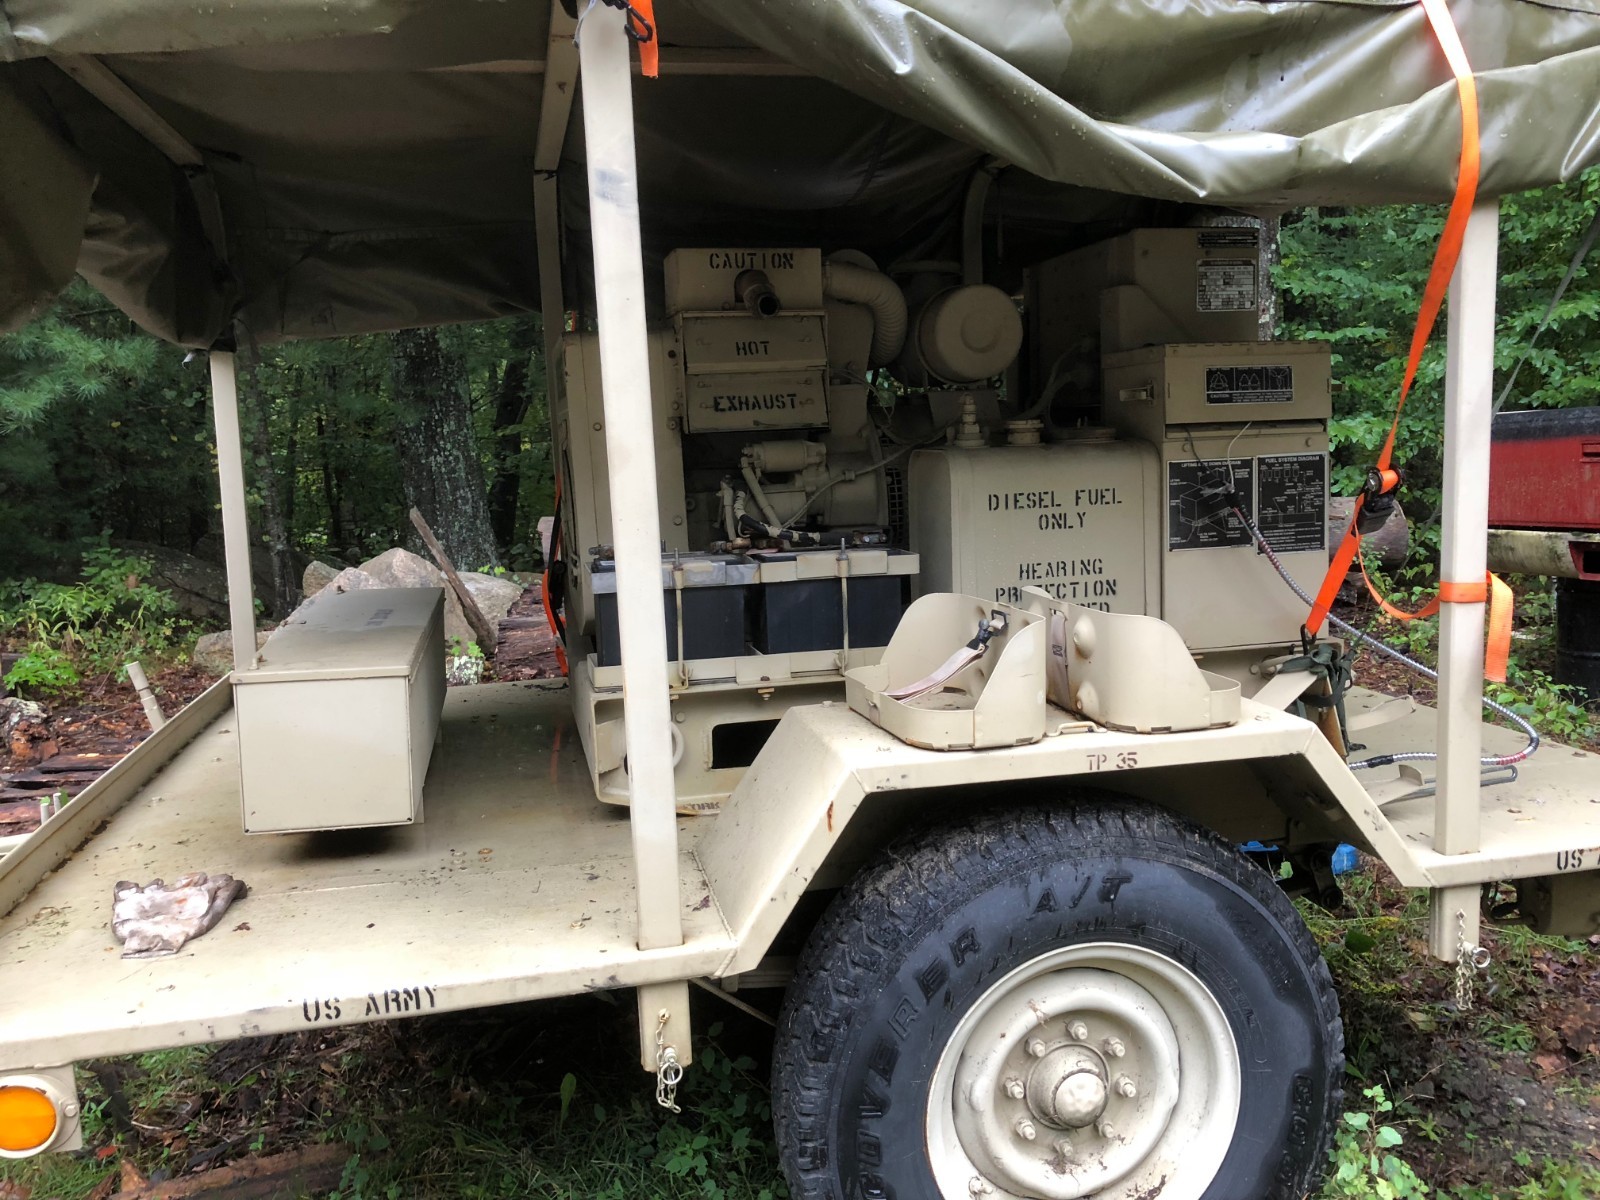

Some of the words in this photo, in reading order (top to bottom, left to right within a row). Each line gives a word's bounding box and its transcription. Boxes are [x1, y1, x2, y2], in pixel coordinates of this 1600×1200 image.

[709, 253, 793, 269] CAUTION
[736, 341, 769, 356] HOT
[713, 394, 797, 412] EXHAUST
[988, 491, 1061, 511] DIESEL
[1075, 488, 1122, 506] FUEL
[1038, 512, 1086, 530] ONLY
[1019, 559, 1103, 580] HEARING
[995, 579, 1117, 603] PRECTION
[1086, 754, 1107, 771] TP
[1116, 752, 1137, 769] 35
[1557, 849, 1582, 870] US
[1029, 872, 1134, 918] A/T
[303, 997, 341, 1022] US
[365, 985, 437, 1016] ARMY
